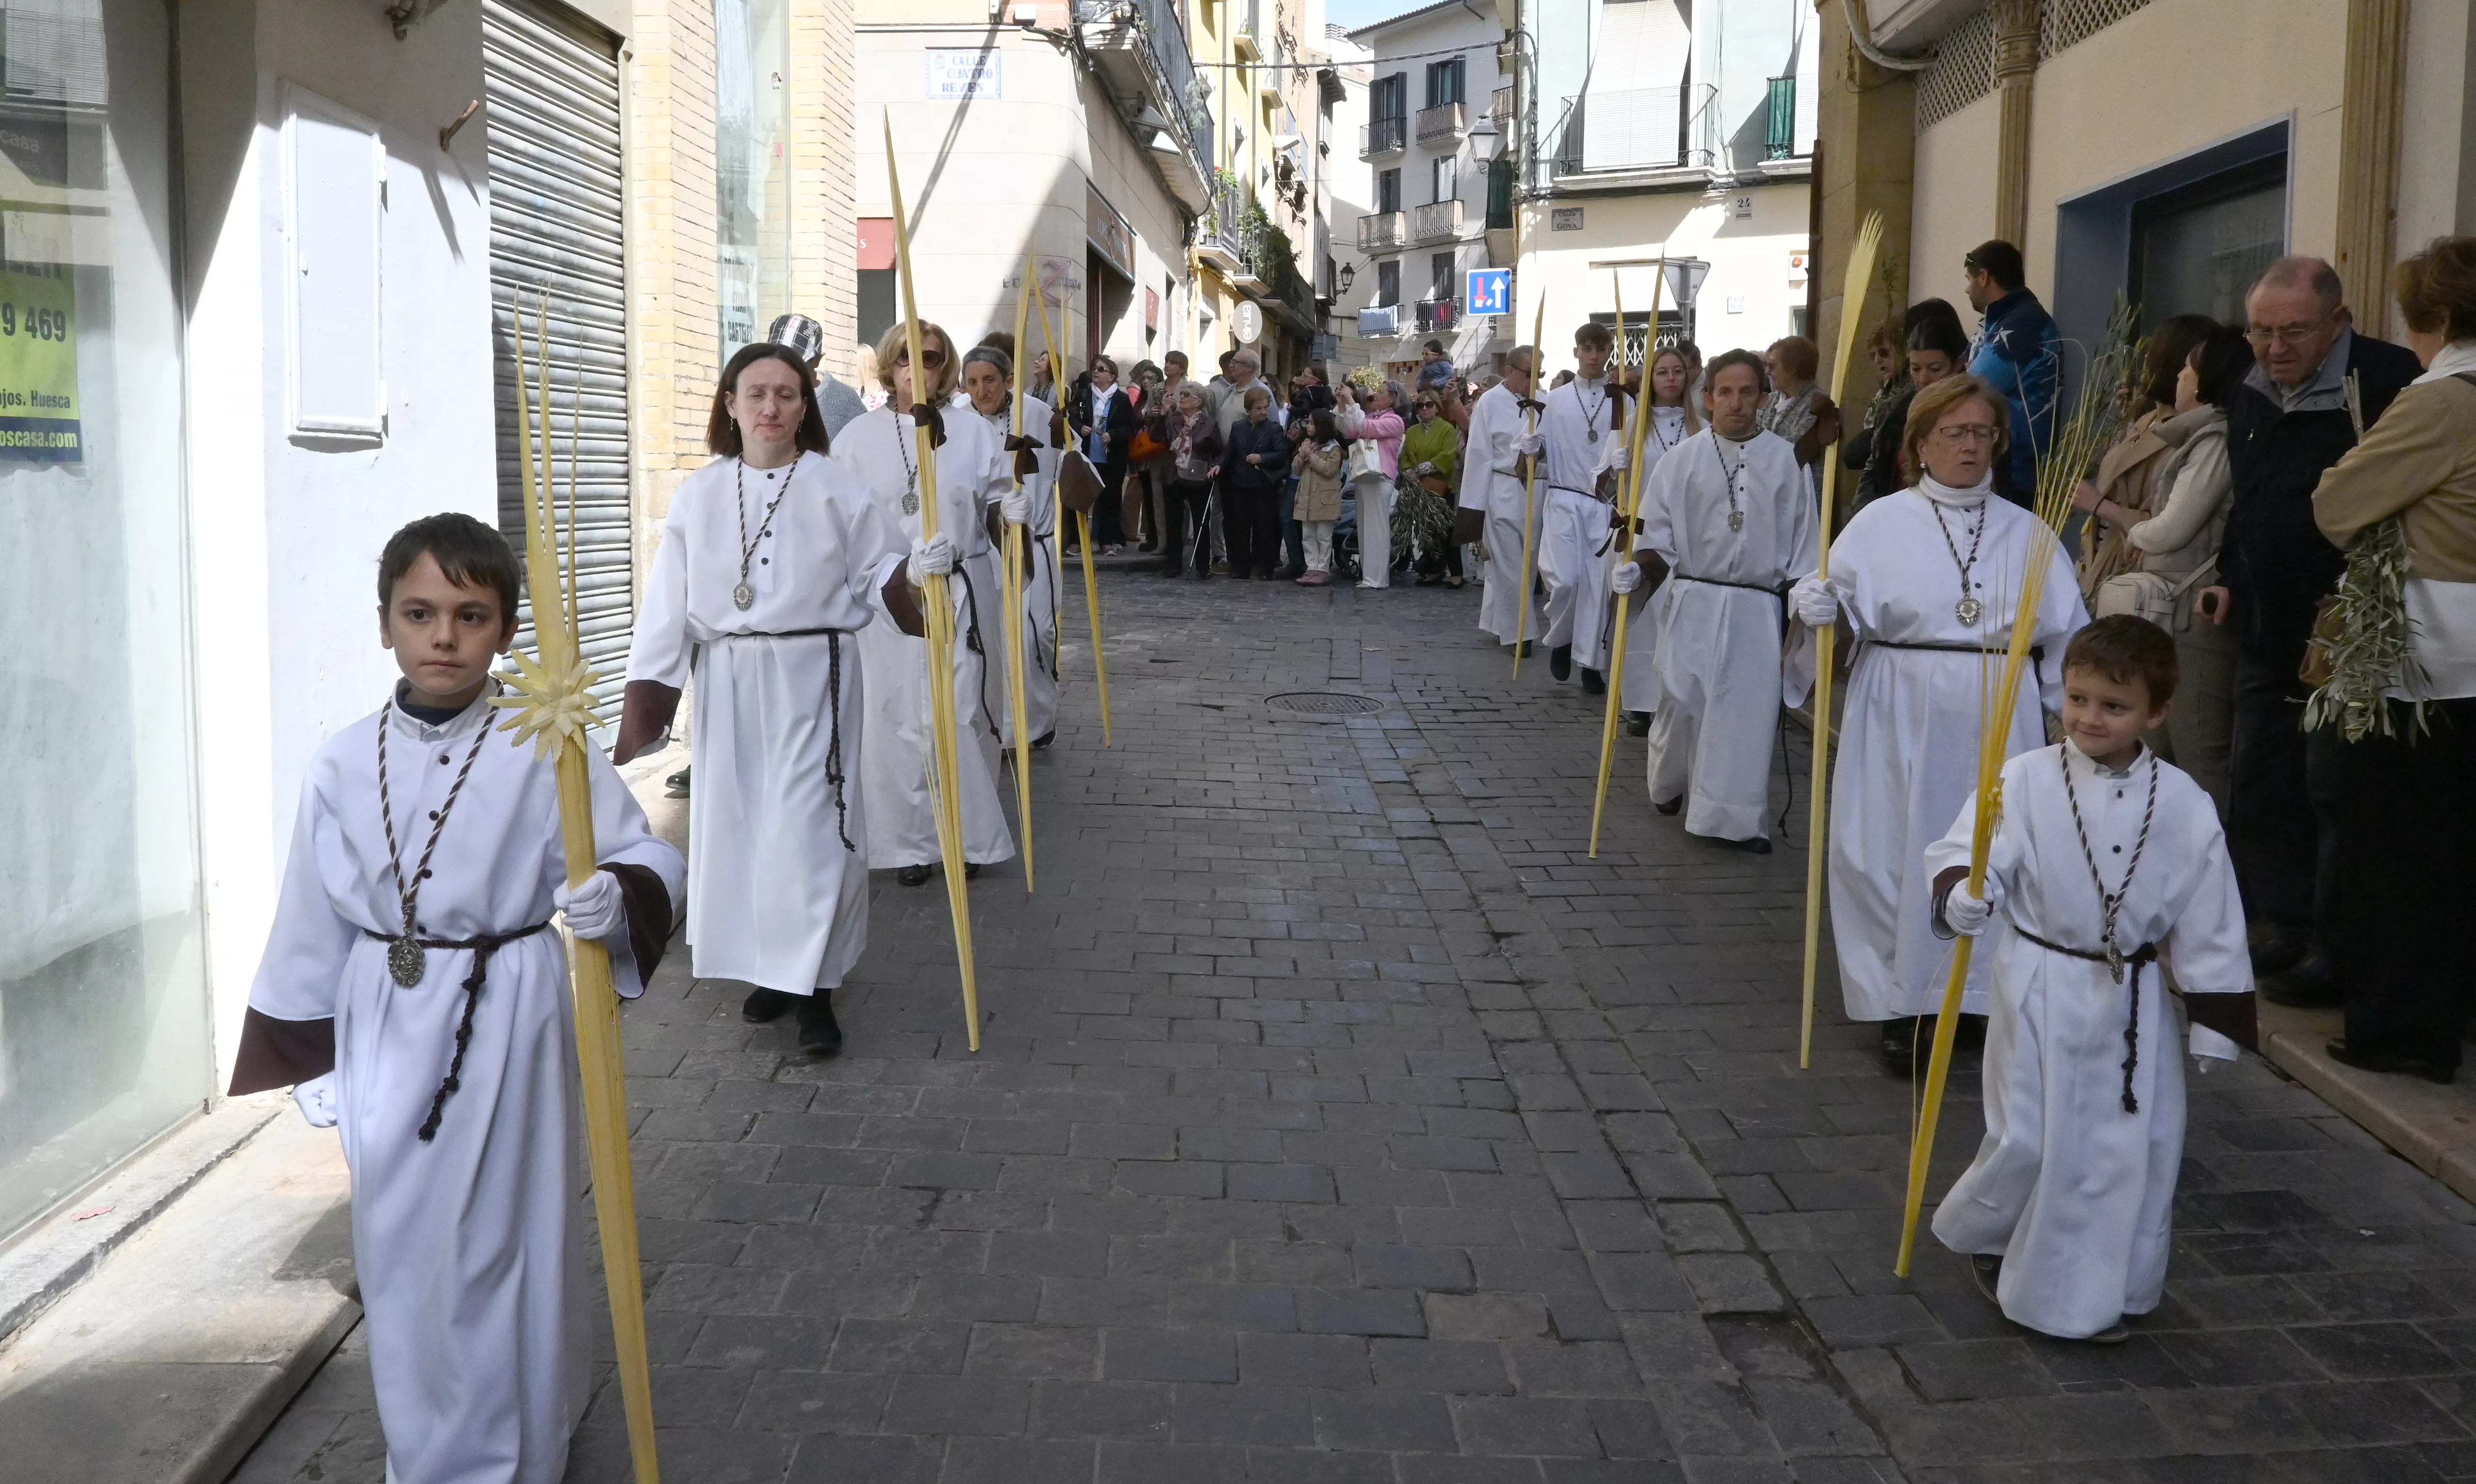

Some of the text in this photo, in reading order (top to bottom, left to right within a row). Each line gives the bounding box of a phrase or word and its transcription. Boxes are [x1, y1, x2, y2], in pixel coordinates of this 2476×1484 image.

[953, 56, 986, 66] CALLE
[947, 69, 993, 78] CUATRO
[942, 82, 984, 93] REYES
[1737, 198, 1751, 207] 24
[25, 306, 66, 342] 469
[727, 320, 753, 344] CARTELES
[0, 388, 71, 409] jos. Huesca
